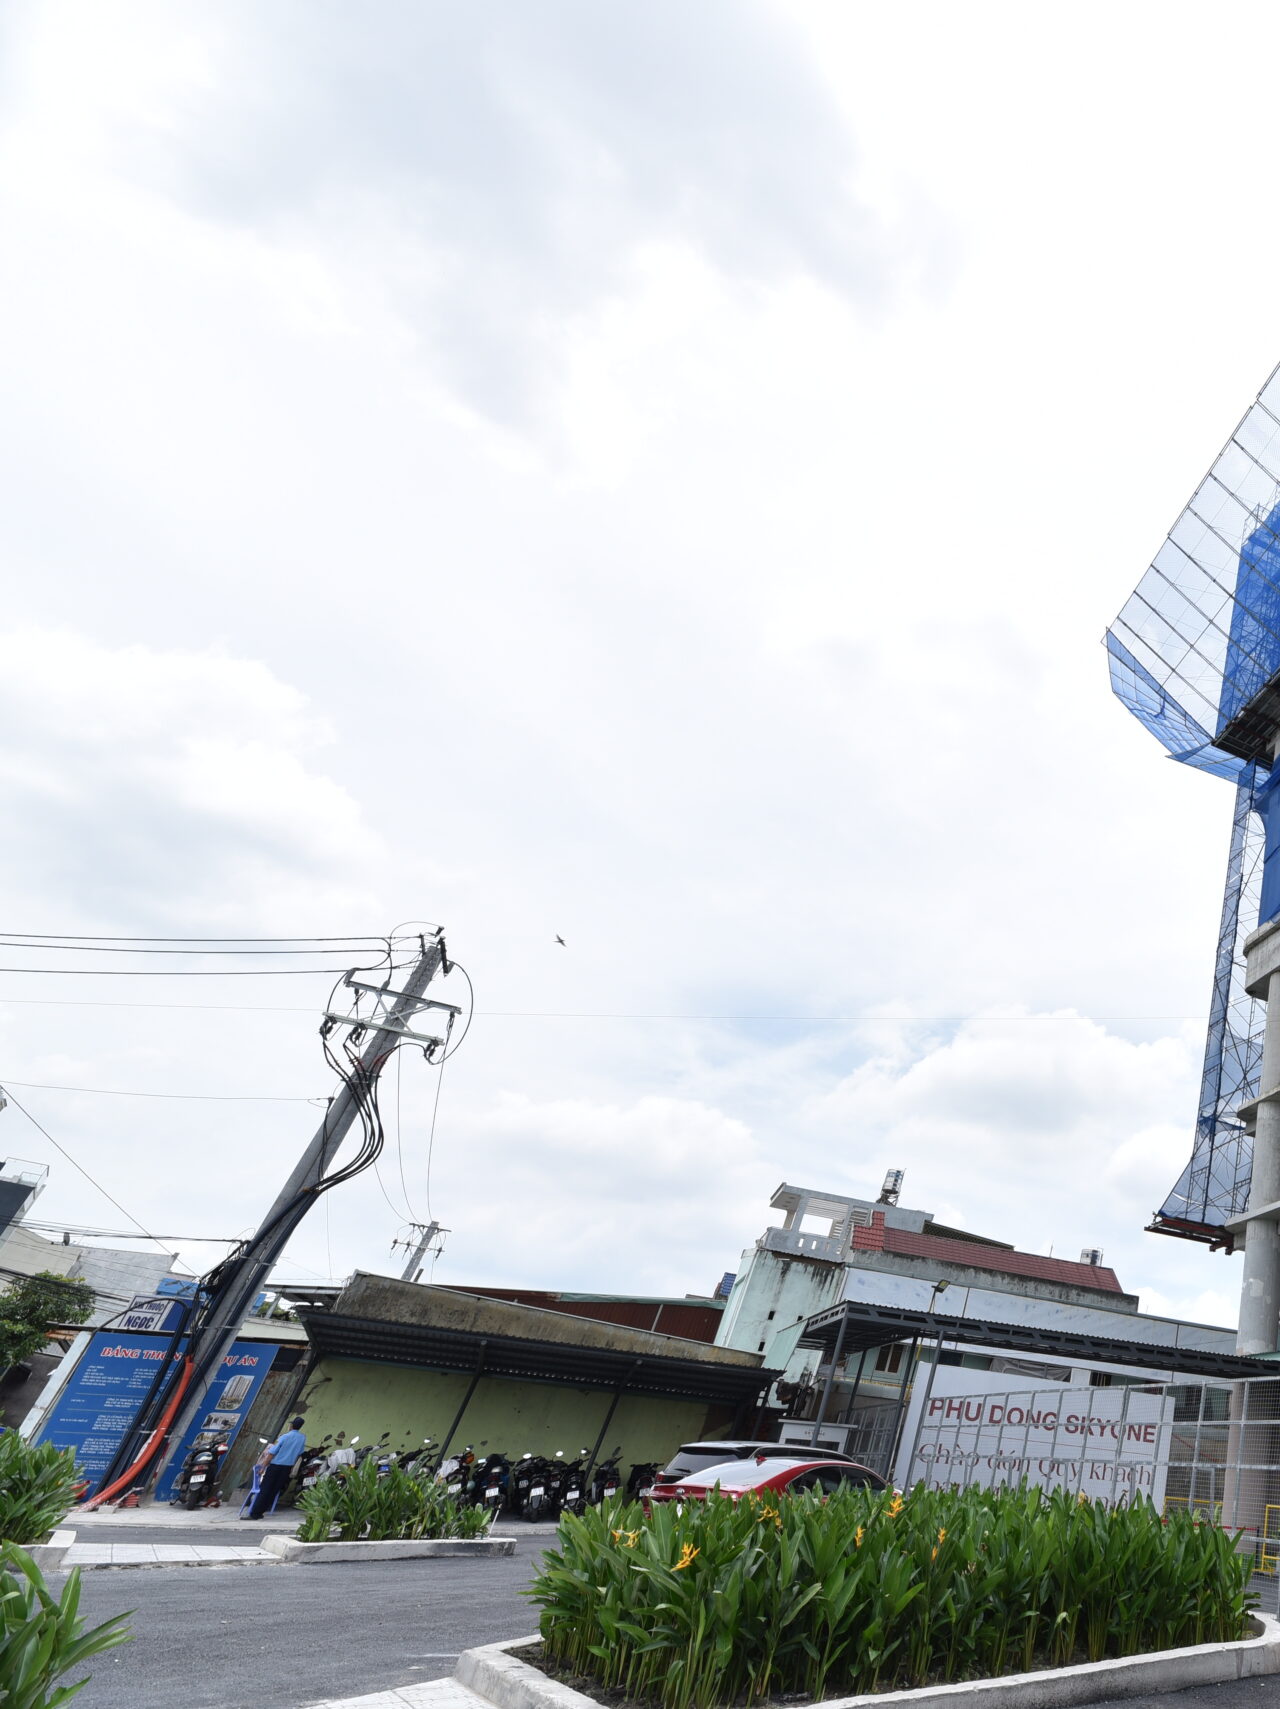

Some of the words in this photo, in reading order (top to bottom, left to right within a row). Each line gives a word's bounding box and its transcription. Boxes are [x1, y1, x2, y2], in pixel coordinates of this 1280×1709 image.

[100, 1345, 141, 1359] BẢNG
[237, 1354, 259, 1366] ÁN
[928, 1399, 983, 1421] PHU
[988, 1404, 1058, 1431] DONG
[1064, 1414, 1157, 1443] SKYONE
